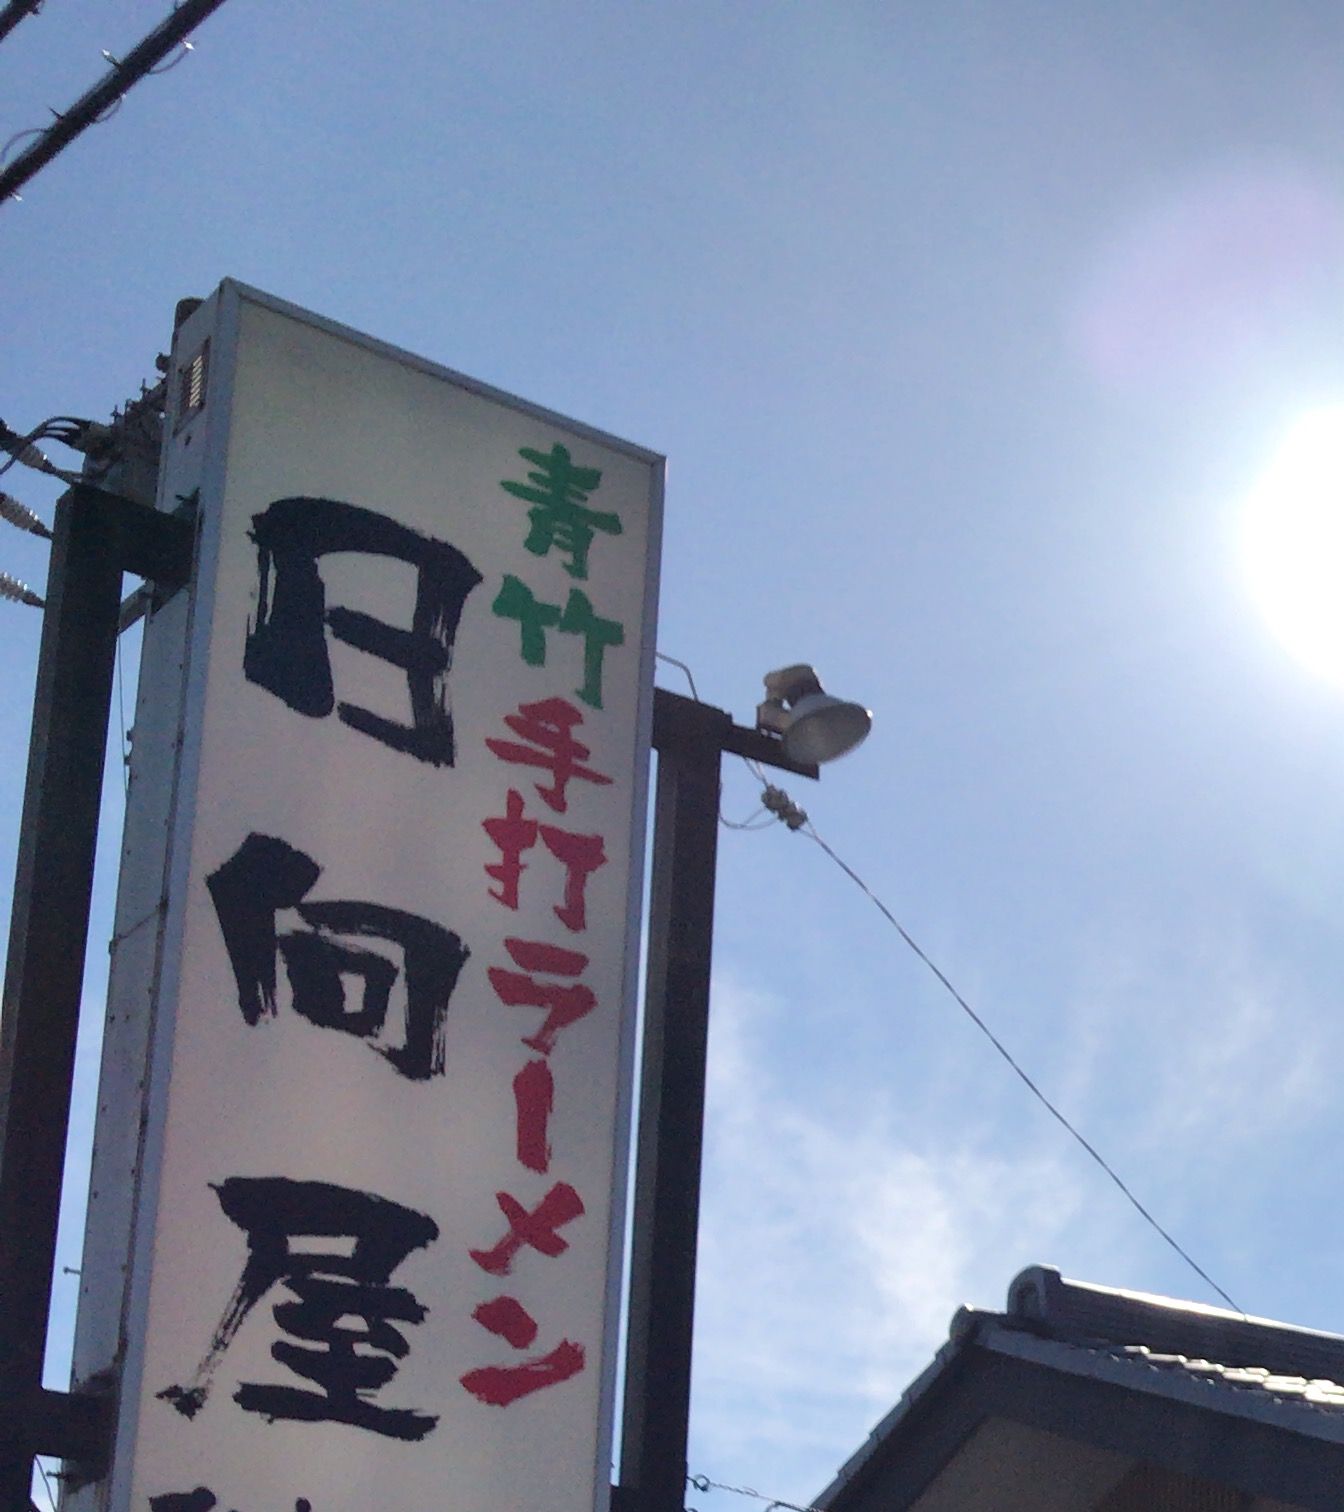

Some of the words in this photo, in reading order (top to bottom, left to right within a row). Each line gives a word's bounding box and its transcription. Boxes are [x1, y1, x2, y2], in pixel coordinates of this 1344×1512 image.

[154, 495, 484, 1442] 日向屋
[459, 442, 625, 1407] 青竹手打ラーメン
